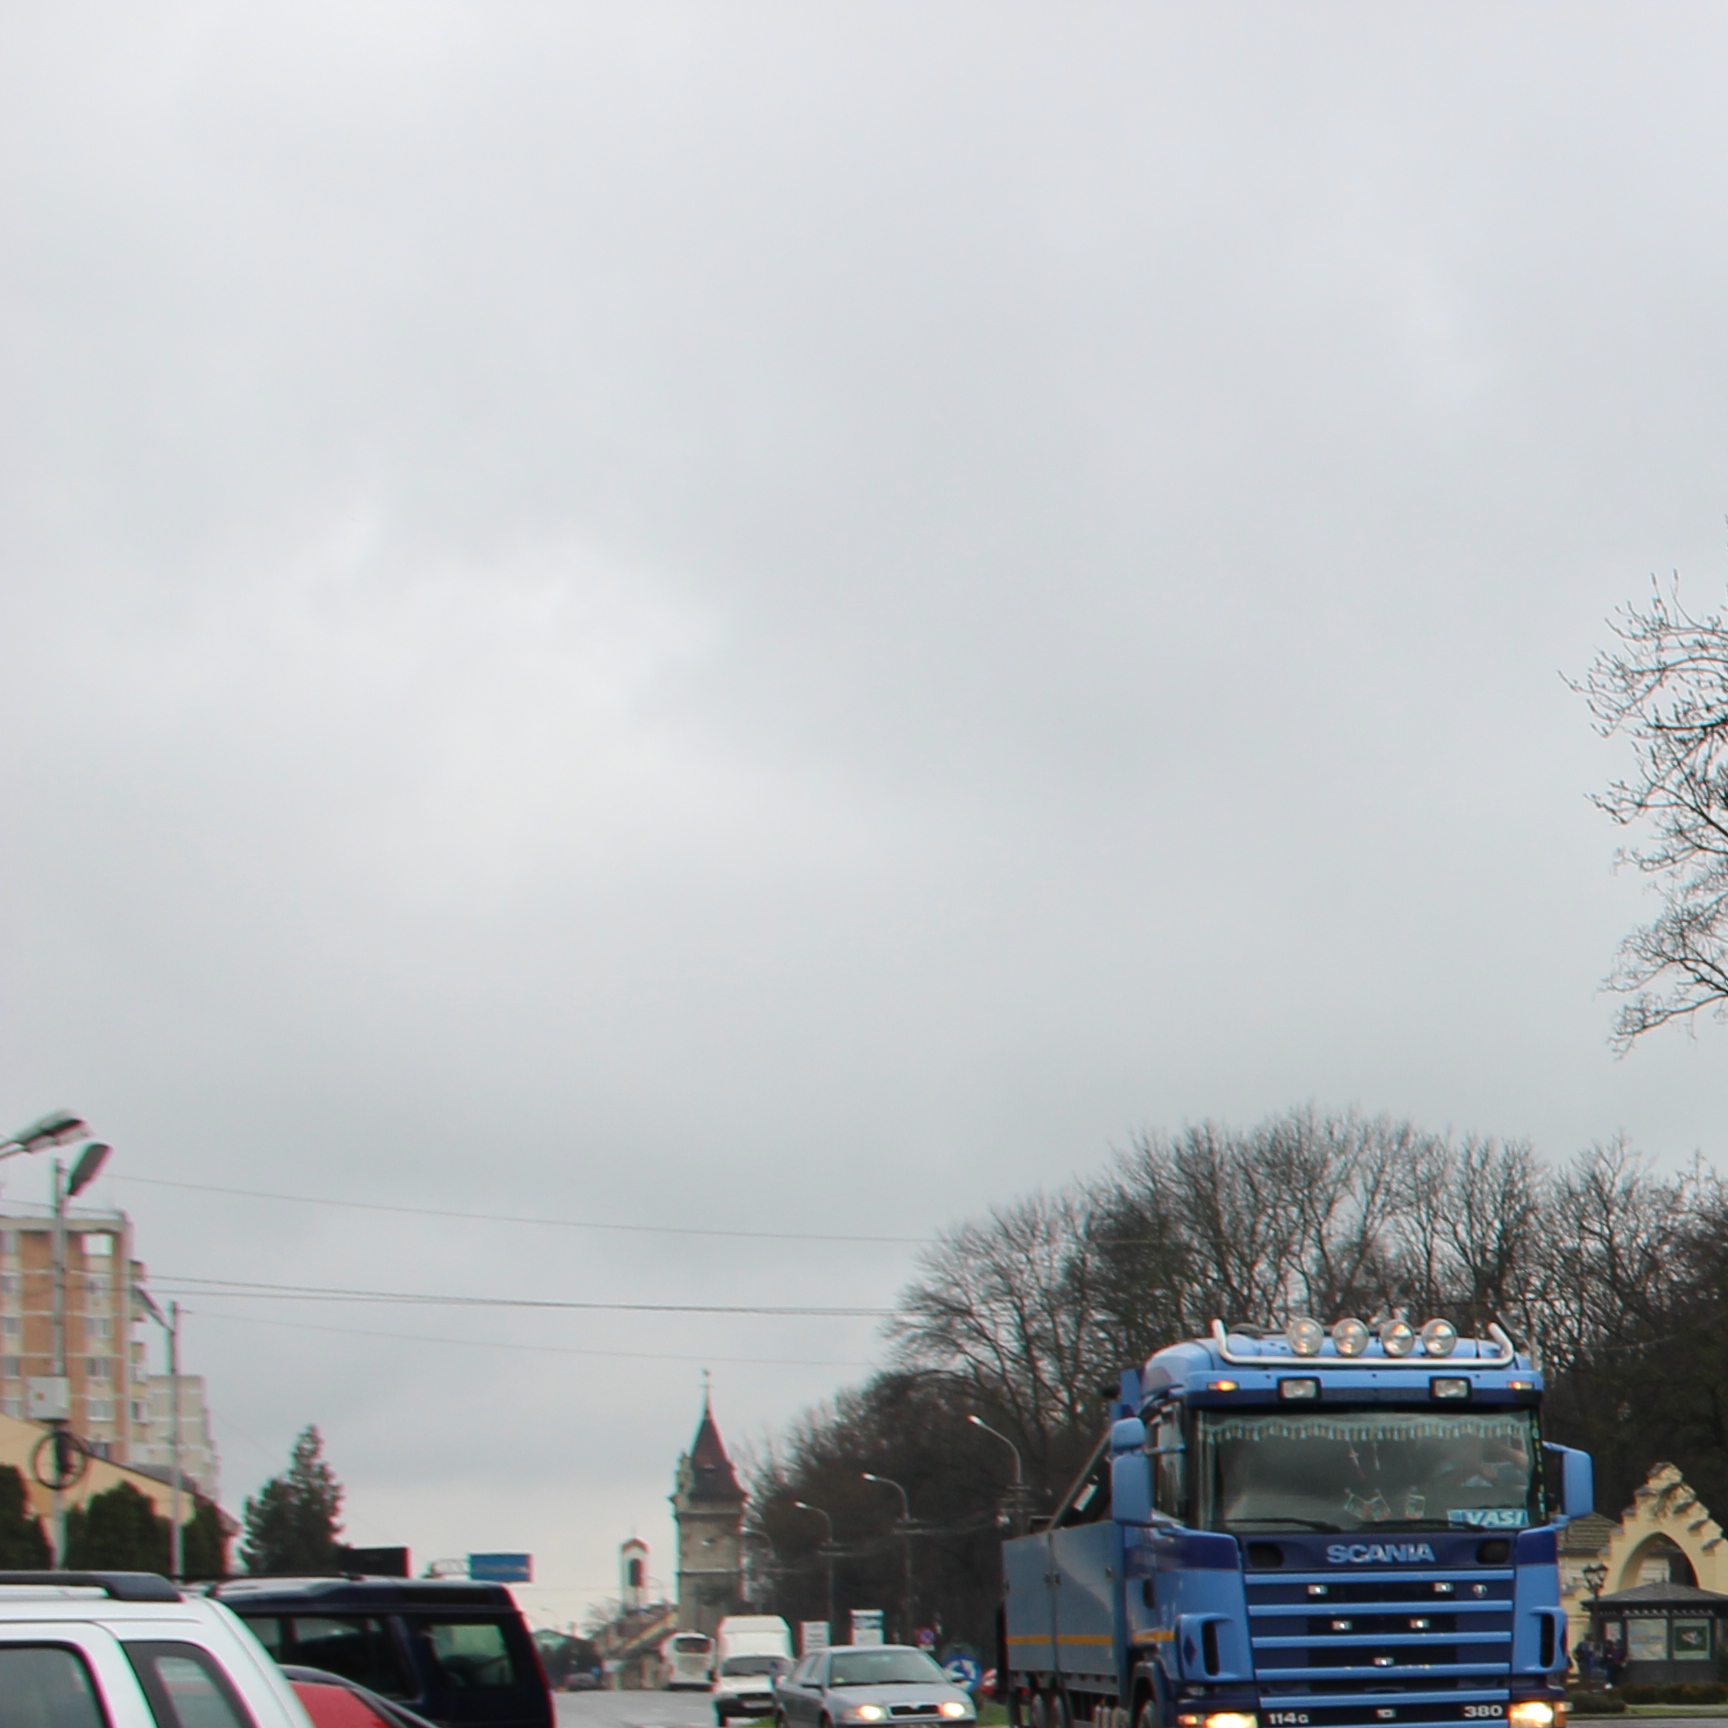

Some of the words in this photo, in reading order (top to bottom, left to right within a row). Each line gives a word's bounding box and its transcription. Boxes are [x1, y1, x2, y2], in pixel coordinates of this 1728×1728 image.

[1466, 1512, 1523, 1526] VASI
[1326, 1543, 1436, 1564] SCANIA
[1464, 1705, 1503, 1718] 380
